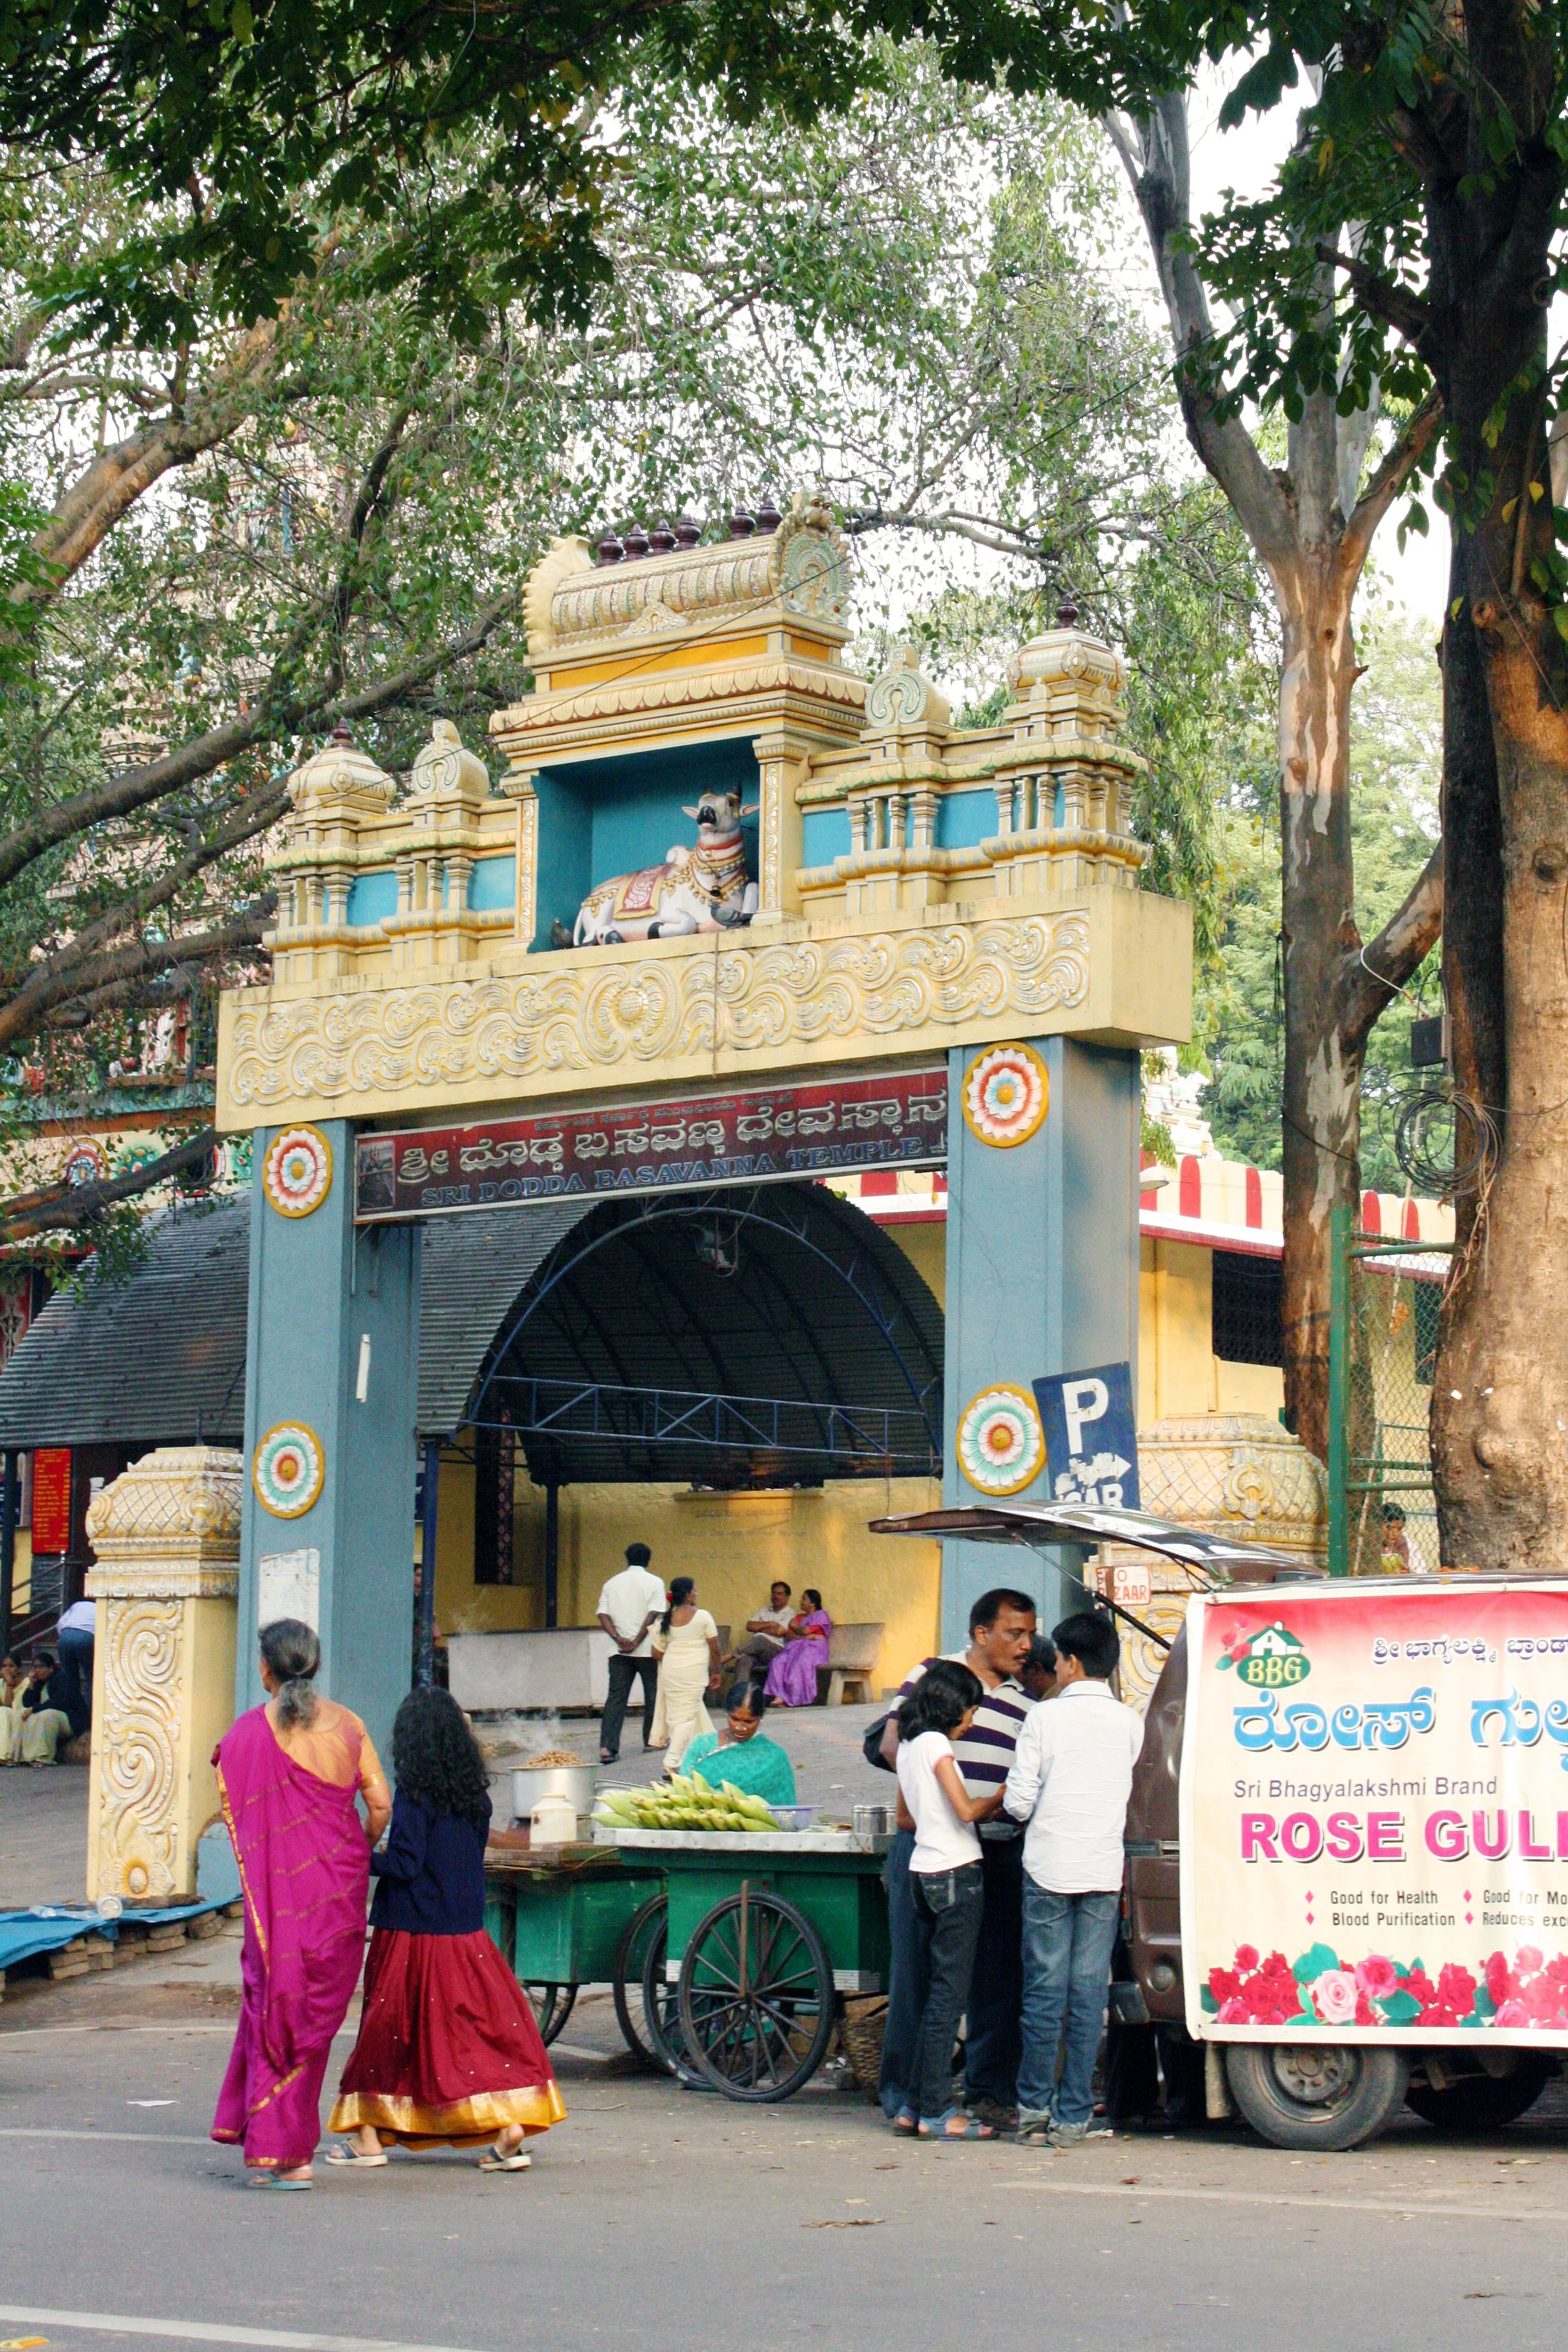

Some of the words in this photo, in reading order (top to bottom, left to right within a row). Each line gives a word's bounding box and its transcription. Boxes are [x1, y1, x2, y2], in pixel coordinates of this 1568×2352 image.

[398, 1145, 450, 1184] ಶ್ರೀ
[460, 1131, 564, 1172] ದೊಡ್ಡ
[574, 1117, 726, 1160] ಬಸವಣ್ಣ
[736, 1088, 948, 1143] ದೇವಸ್ಥಾನ
[421, 1184, 470, 1207] SRI
[479, 1172, 586, 1202] DODDA
[595, 1152, 777, 1190] BASAVANNA
[786, 1136, 923, 1169] TEMPLE
[1062, 1378, 1109, 1454] P
[1374, 1639, 1399, 1665] ಶ್ರೀ
[1246, 1654, 1302, 1686] BBG
[1232, 1688, 1435, 1749] ರೋಸ್
[1234, 1780, 1261, 1799] Sri
[1269, 1777, 1427, 1803] Bhagyalakshmi
[1436, 1776, 1497, 1796] Brand
[1241, 1811, 1405, 1863] ROSE
[1330, 1890, 1363, 1905] Good
[1370, 1890, 1389, 1905] for
[1396, 1890, 1438, 1905] Health
[1483, 1889, 1510, 1904] Good
[1520, 1890, 1539, 1904] for
[1332, 1913, 1369, 1927] Blood
[1377, 1912, 1455, 1927] Purification
[1482, 1911, 1535, 1926] Reduces
